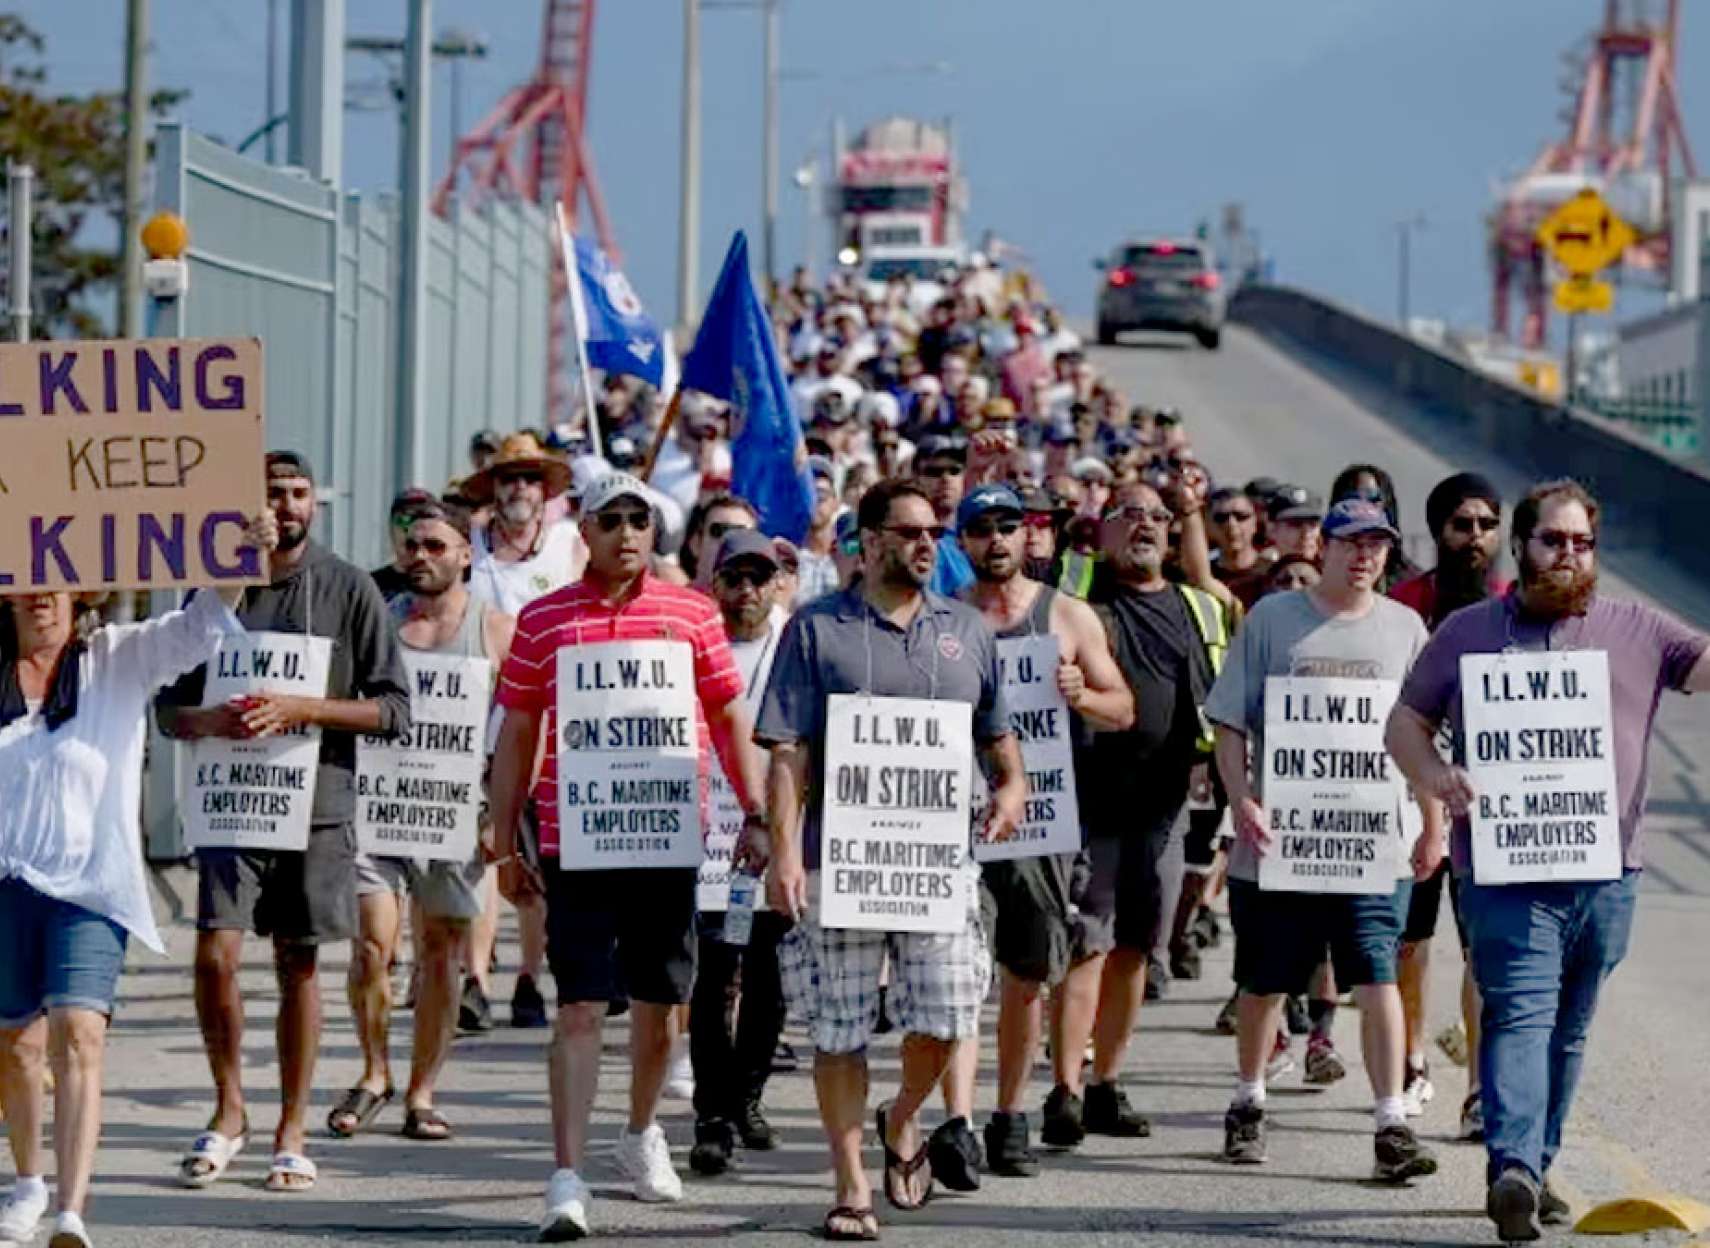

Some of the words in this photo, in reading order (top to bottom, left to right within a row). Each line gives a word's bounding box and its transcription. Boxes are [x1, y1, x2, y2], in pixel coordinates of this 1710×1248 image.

[0, 345, 245, 415] KING
[67, 435, 205, 490] KEEP
[0, 512, 261, 585] KING
[576, 659, 675, 691] I.L.W.U.
[1483, 670, 1588, 702] I.L.W.U.
[1284, 694, 1379, 724] I.L.W.U.
[608, 716, 690, 748] STRIKE
[853, 714, 945, 748] I.L.W.U.
[1477, 729, 1510, 761] ON
[1518, 726, 1604, 760] STRIKE
[229, 764, 308, 790] MARITIME
[1273, 748, 1305, 776] ON
[1311, 749, 1391, 781] STRIKE
[358, 774, 389, 797] B.C.
[395, 775, 472, 805] MARITIME
[568, 780, 605, 807] B.C.
[611, 780, 692, 805] MARITIME
[836, 764, 870, 805] ON
[878, 765, 960, 809] STRIKE
[202, 789, 291, 816] EMPLOYERS
[366, 800, 457, 829] EMPLOYERS
[1479, 792, 1519, 819] B.C.
[1524, 791, 1608, 817] MARITIME
[582, 809, 681, 834] EMPLOYERS
[1270, 808, 1305, 831] B.C.
[1310, 808, 1389, 834] MARITIME
[1496, 820, 1598, 848] EMPLOYERS
[829, 837, 863, 866] B.C.
[864, 839, 961, 870] MARITIME
[1281, 835, 1375, 861] EMPLOYERS
[834, 868, 953, 899] EMPLOYERS
